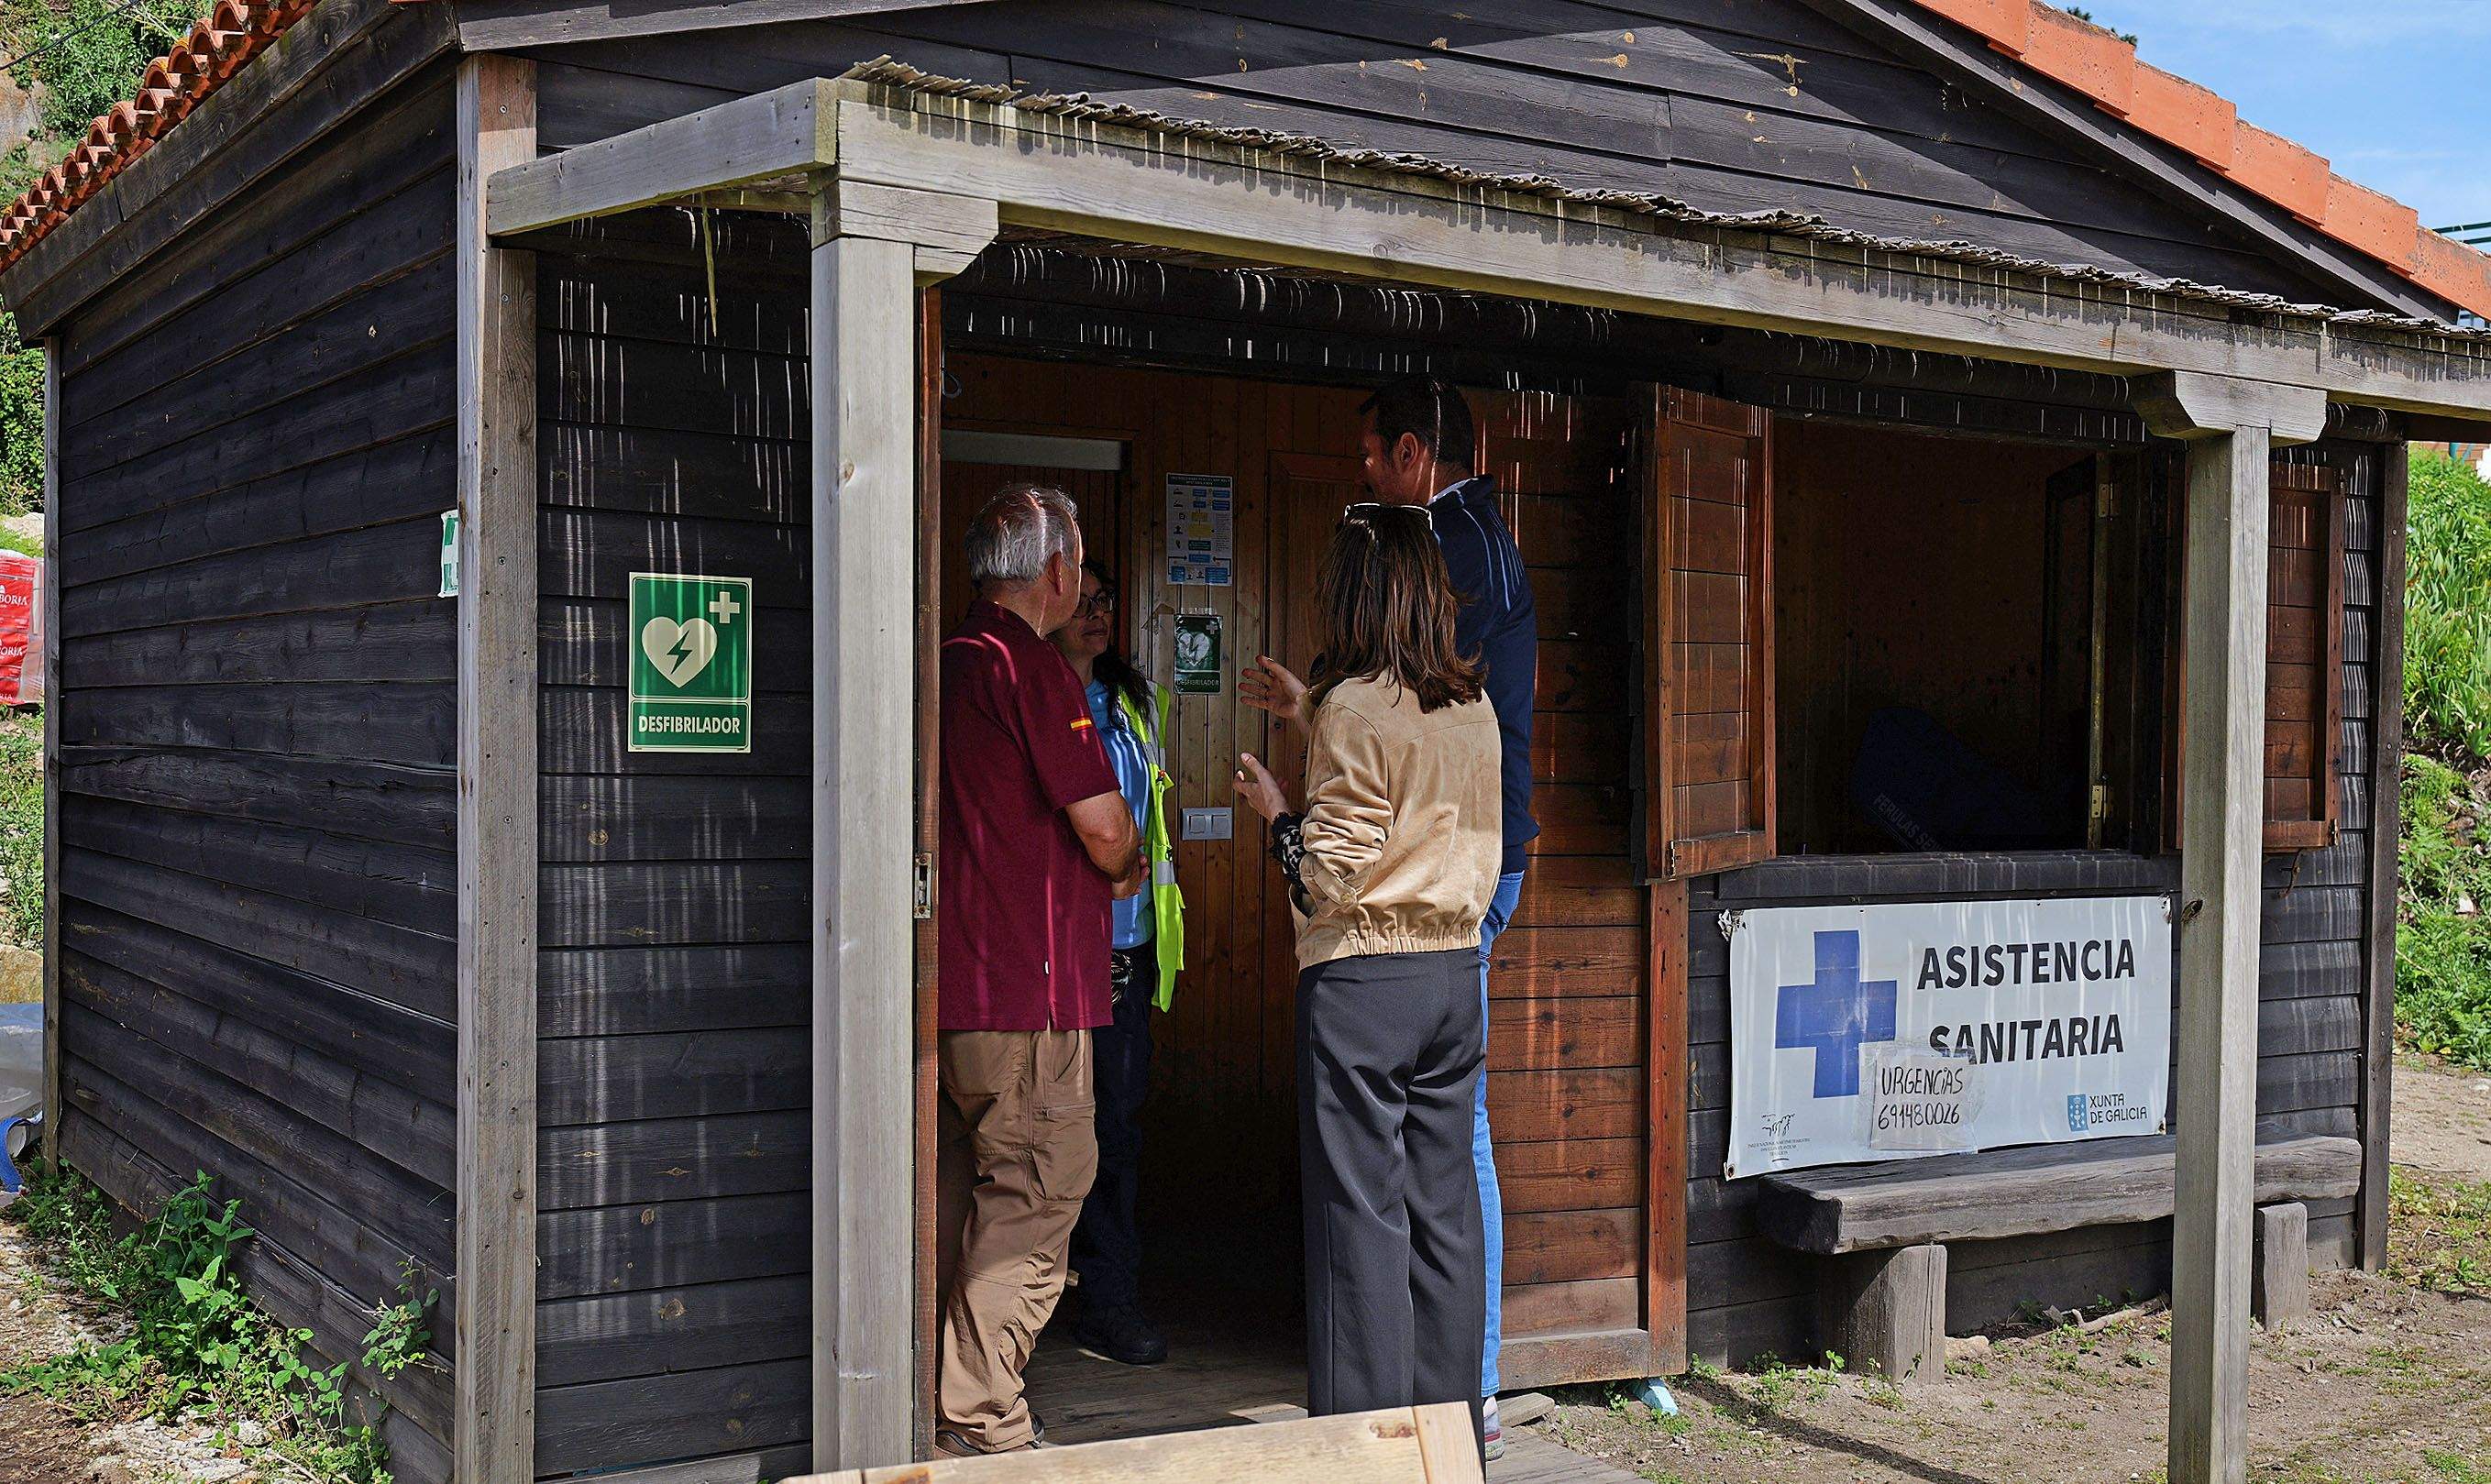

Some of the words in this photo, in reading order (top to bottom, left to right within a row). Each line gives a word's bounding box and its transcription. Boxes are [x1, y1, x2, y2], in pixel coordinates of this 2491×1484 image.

[638, 715, 740, 733] DESFIBRILADOR
[1917, 939, 2135, 990] ASISTENCIA
[1929, 1014, 2124, 1065] SANITARIA
[2089, 1094, 2125, 1108] XUNTA
[1878, 1102, 1960, 1130] 691480026
[2090, 1110, 2103, 1124] DE
[2105, 1106, 2148, 1123] GALICIA
